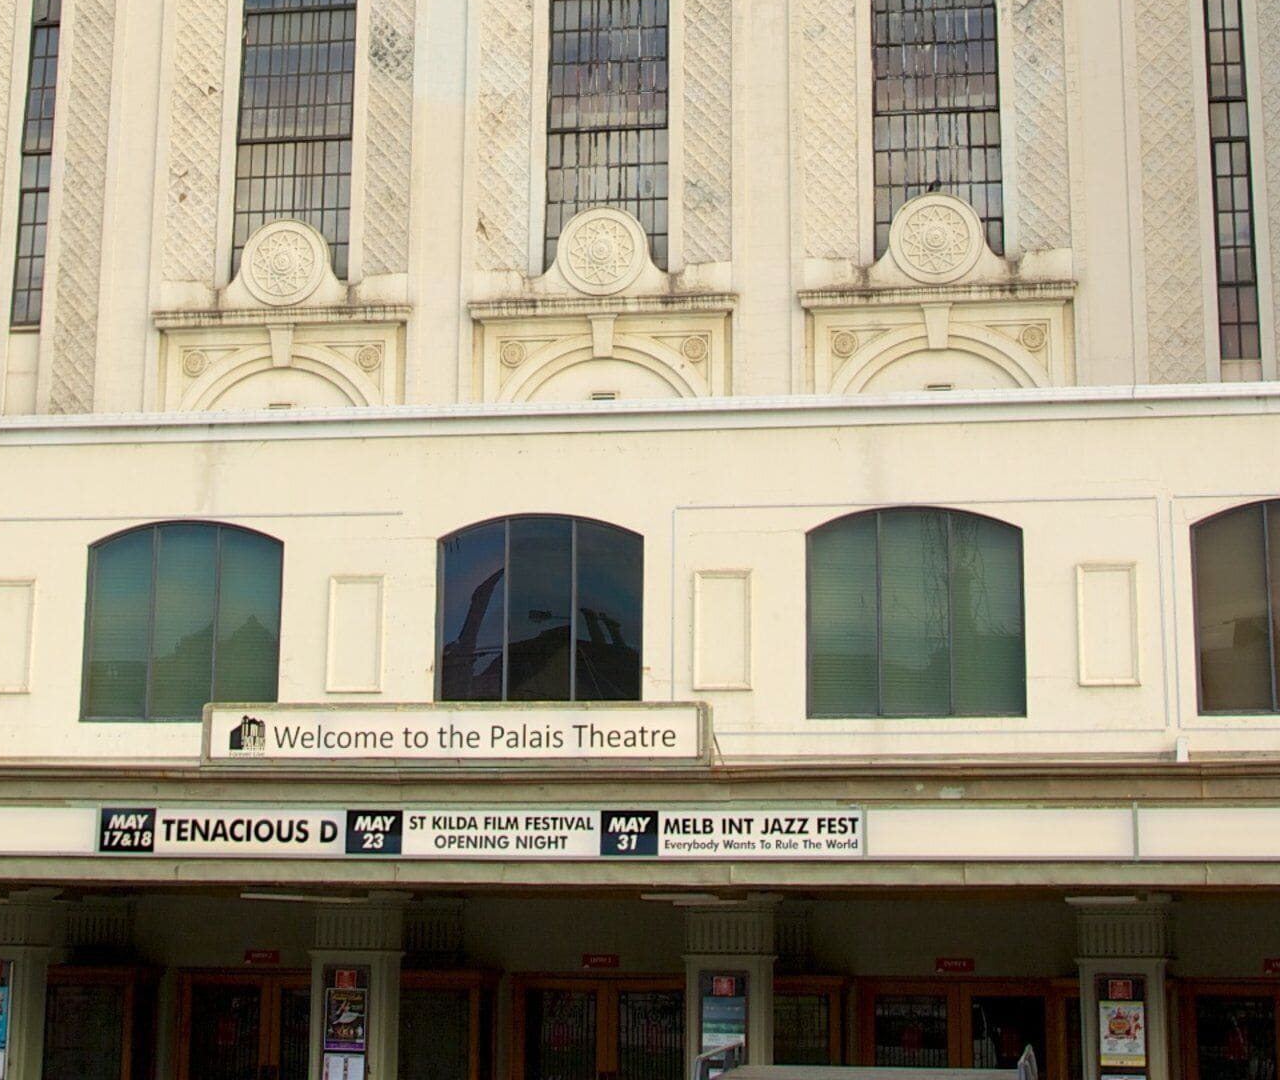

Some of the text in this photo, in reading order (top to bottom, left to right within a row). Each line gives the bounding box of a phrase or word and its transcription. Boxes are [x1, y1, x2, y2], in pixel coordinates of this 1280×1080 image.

[273, 724, 394, 749] Welcome
[403, 726, 430, 749] to
[437, 723, 480, 749] the
[490, 723, 564, 749] Palais
[572, 723, 677, 749] Theatre
[108, 814, 149, 829] MAY
[353, 815, 396, 832] MAY
[408, 816, 594, 831] ST KILDA FILM FESTIVAL
[608, 816, 651, 833] MAY
[663, 817, 860, 835] MELB INT JAZZ FEST
[102, 830, 153, 847] 17&18
[161, 818, 339, 843] TENACIOUS D
[362, 834, 384, 849] 23
[433, 834, 569, 850] OPENING NIGHT
[616, 834, 639, 850] 31
[664, 839, 858, 852] Everybody Wants To Rule The World
